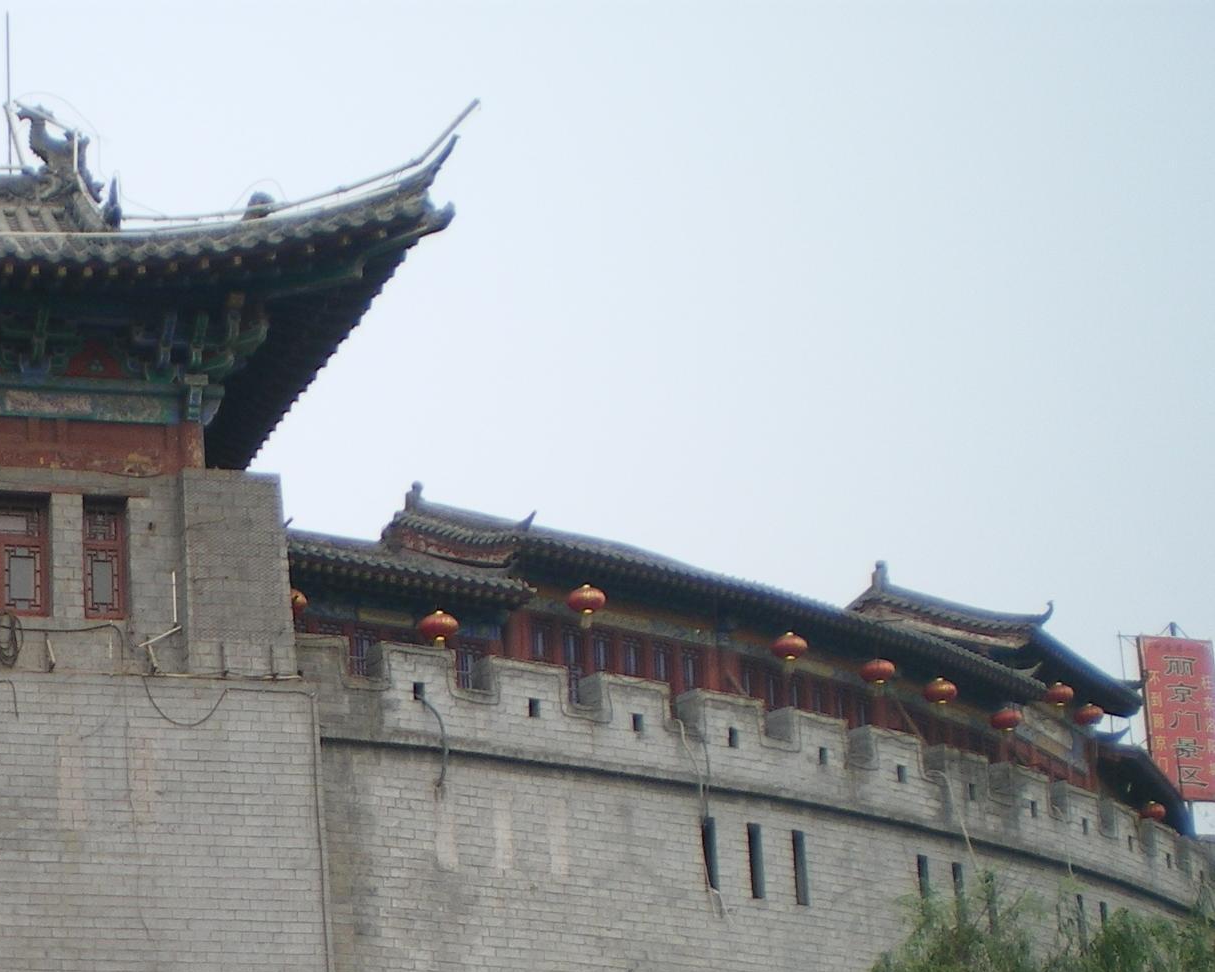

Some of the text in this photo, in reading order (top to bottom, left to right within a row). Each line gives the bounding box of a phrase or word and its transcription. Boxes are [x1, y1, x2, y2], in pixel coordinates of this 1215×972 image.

[1162, 654, 1209, 788] 丽京门景区
